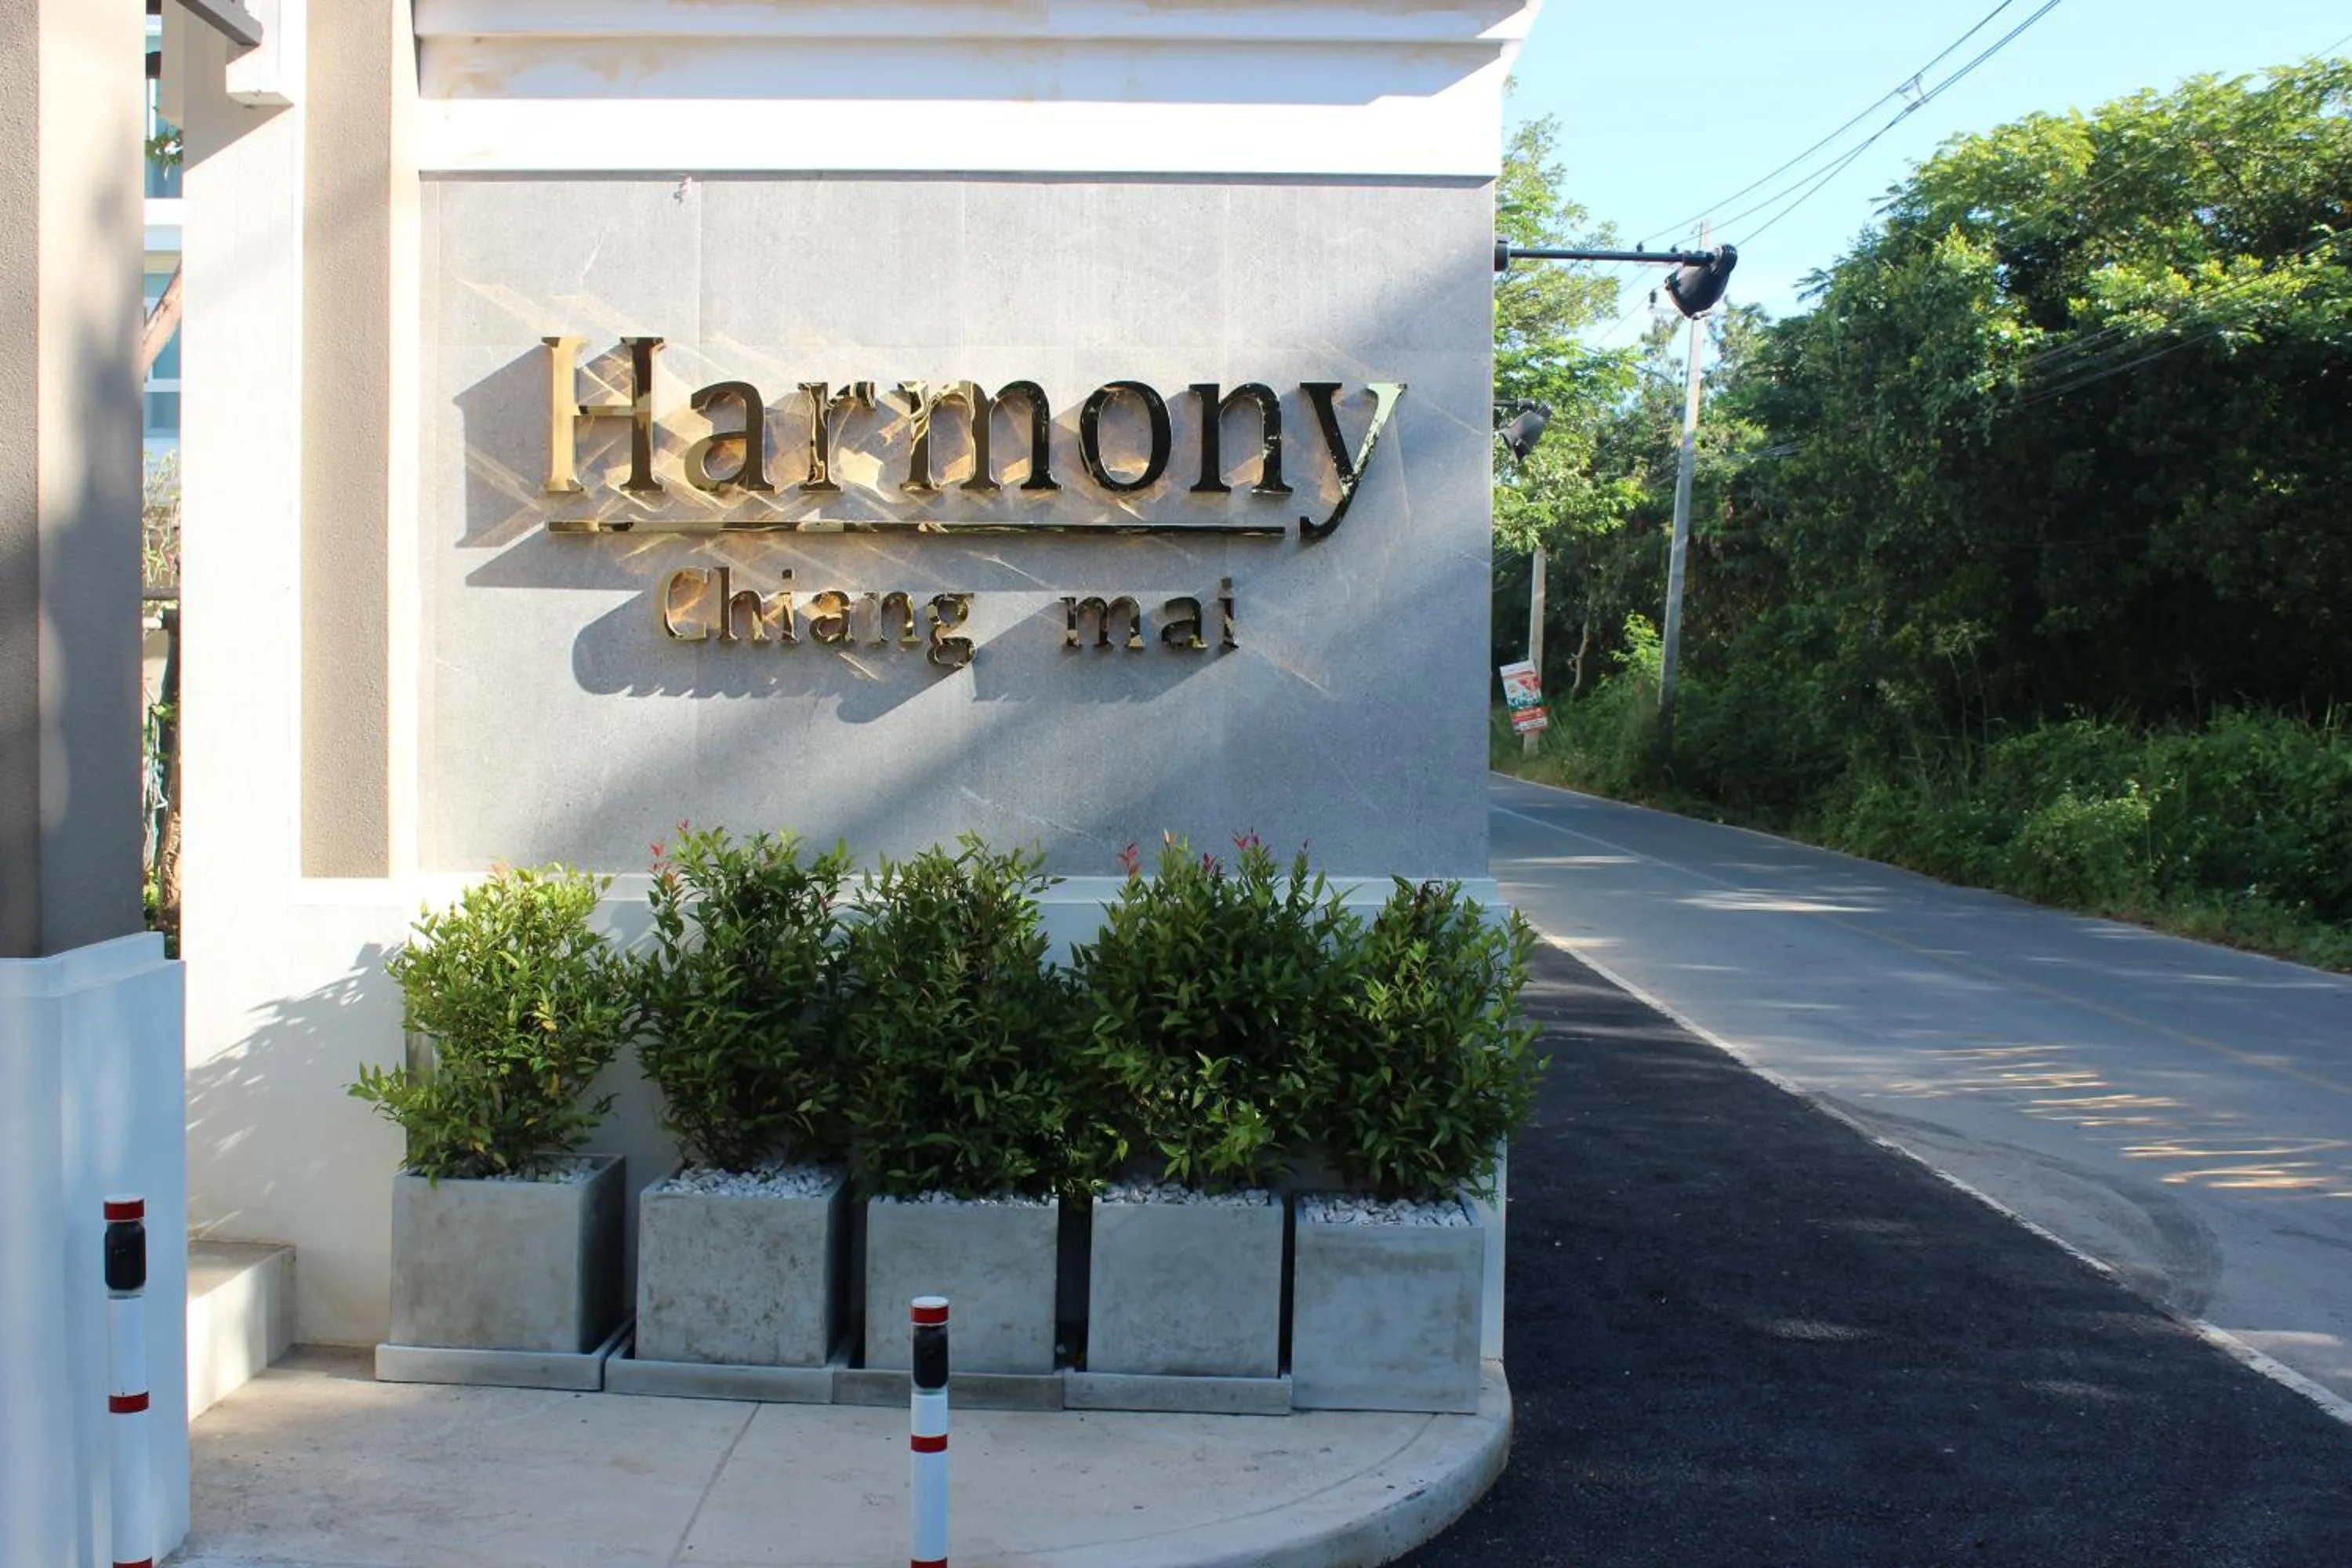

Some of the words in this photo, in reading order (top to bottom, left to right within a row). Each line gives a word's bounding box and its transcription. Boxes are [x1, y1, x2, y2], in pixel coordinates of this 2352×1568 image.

[541, 336, 1407, 539] Harmony
[655, 567, 977, 668] Chiang
[1060, 577, 1240, 649] mai
